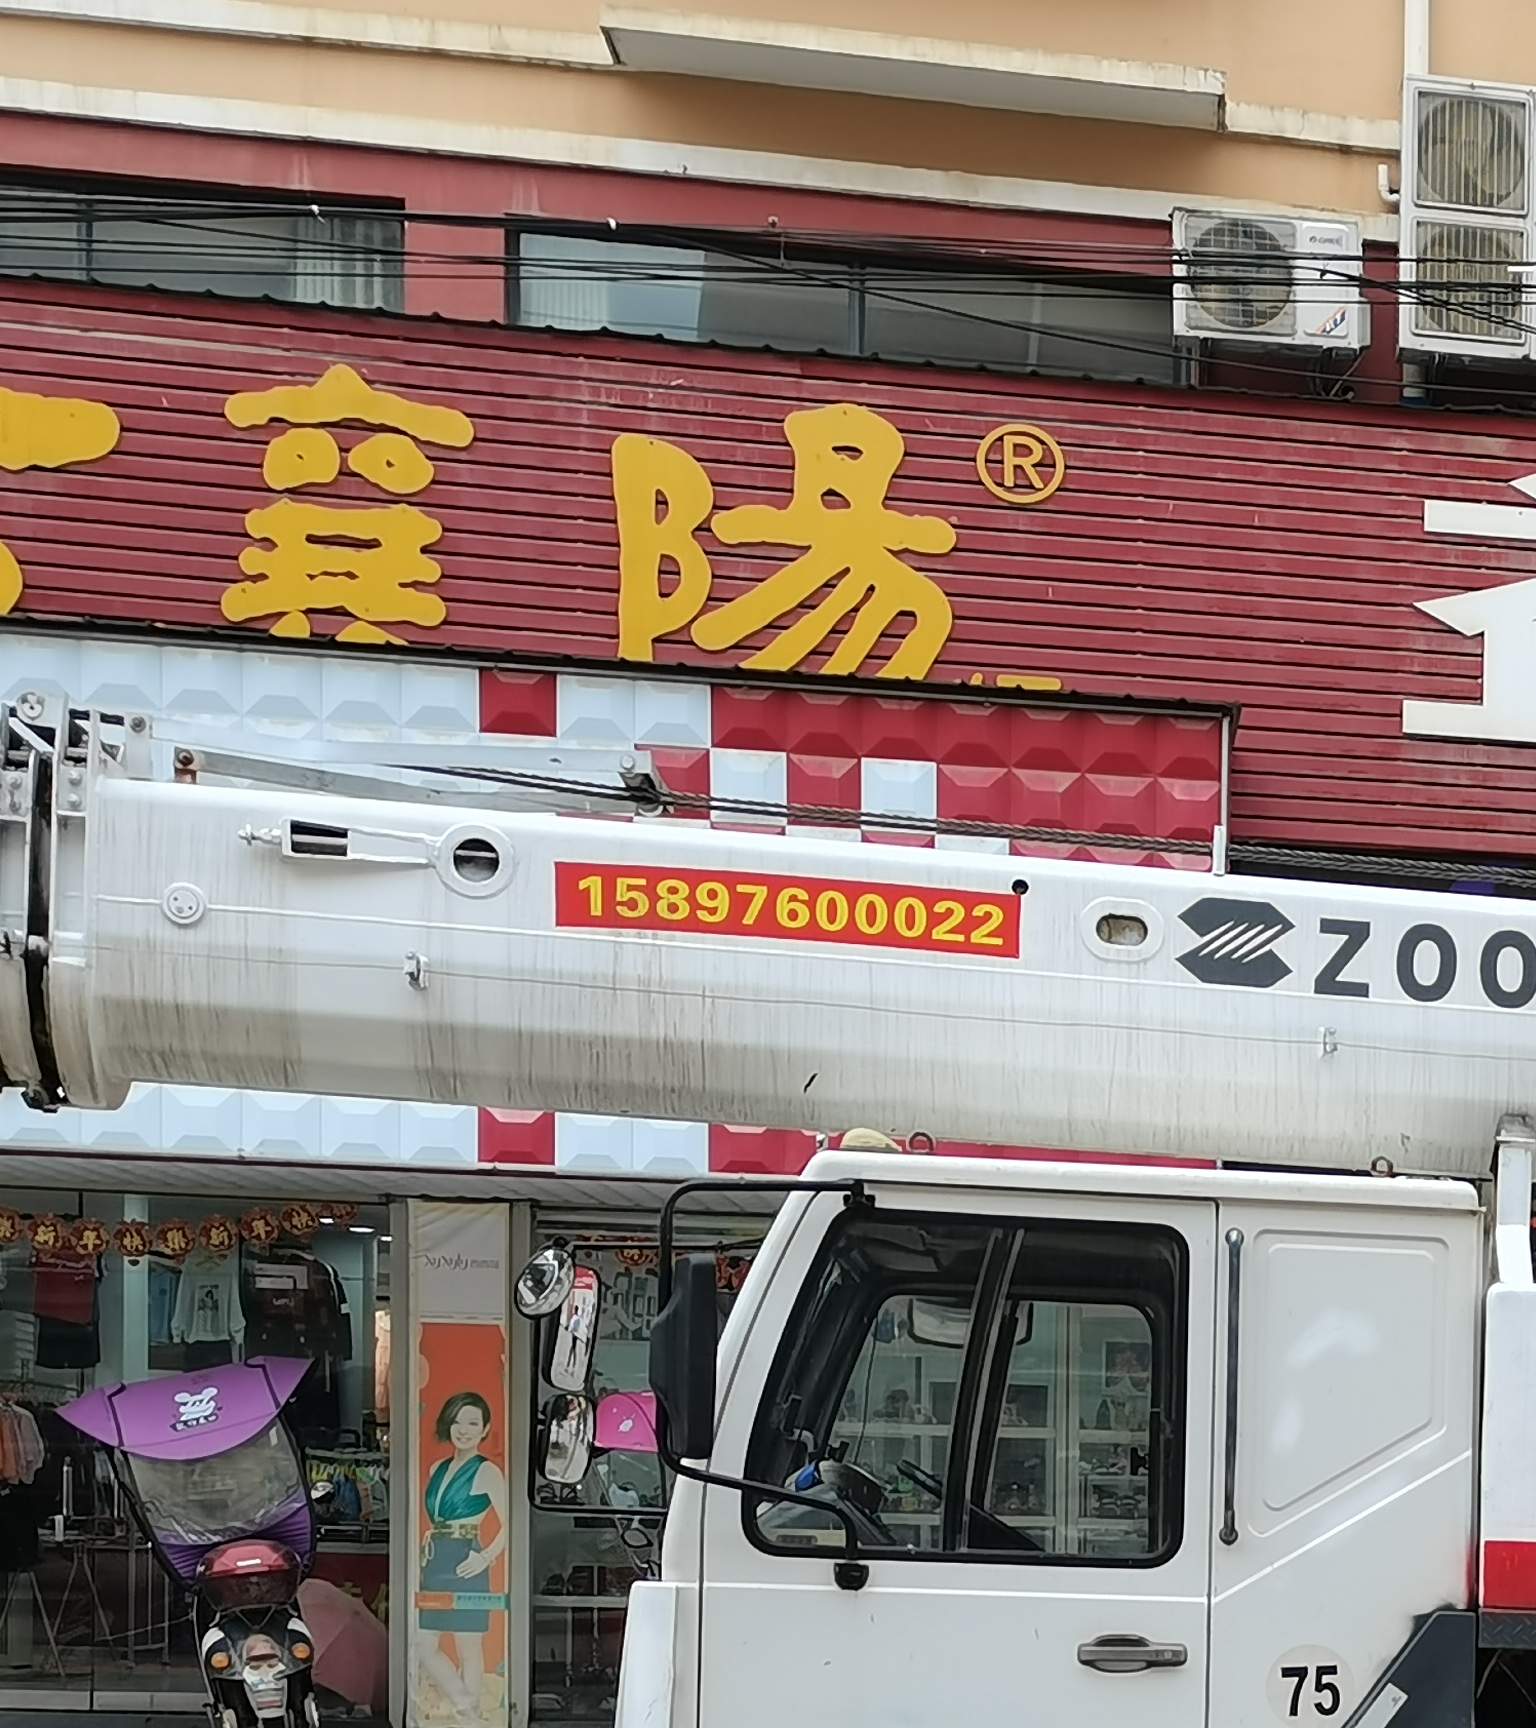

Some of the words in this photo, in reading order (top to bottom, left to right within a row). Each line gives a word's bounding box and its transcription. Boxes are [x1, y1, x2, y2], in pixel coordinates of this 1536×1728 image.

[0, 364, 957, 682] 襄陽
[578, 875, 1005, 946] 15897600022
[1280, 1664, 1342, 1718] 75
